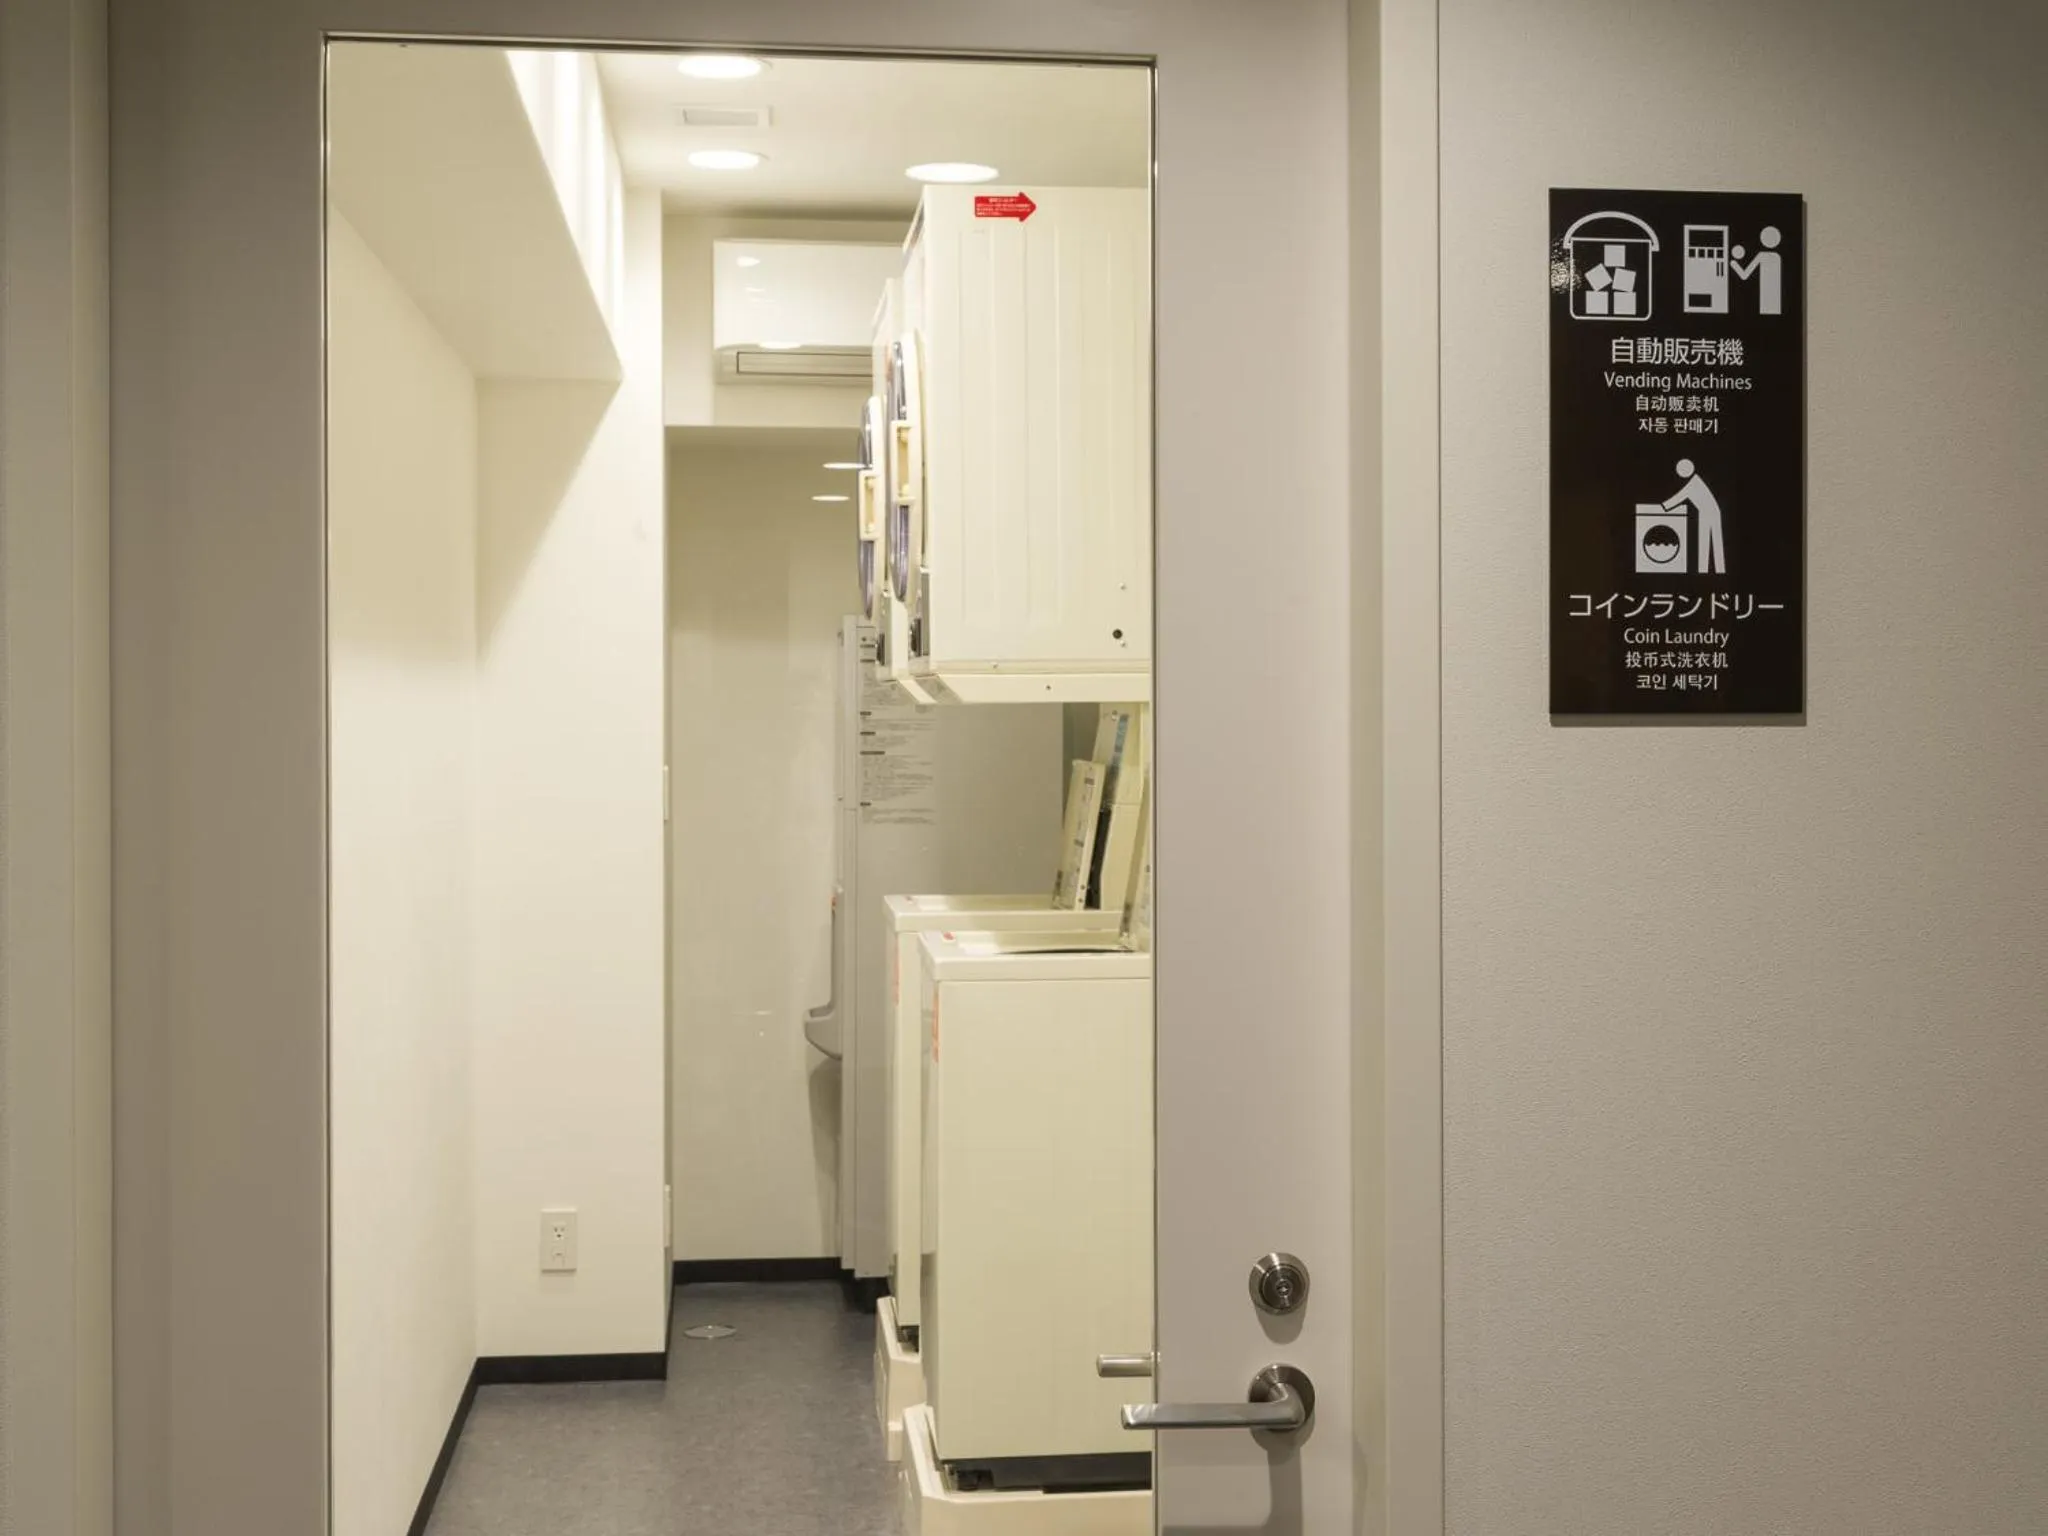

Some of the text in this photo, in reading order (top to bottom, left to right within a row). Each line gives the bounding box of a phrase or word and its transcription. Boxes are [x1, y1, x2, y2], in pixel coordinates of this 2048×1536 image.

[1611, 336, 1744, 366] 自動販売機
[1603, 371, 1752, 392] Vending Machines
[1635, 394, 1720, 413] 自动贩卖机
[1638, 417, 1718, 434] 자동 판매기
[1569, 592, 1784, 620] コインランドリー
[1623, 627, 1730, 648] Coin Laundry
[1625, 651, 1729, 669] 投币式洗衣机
[1636, 674, 1718, 691] 코인 세탁기
